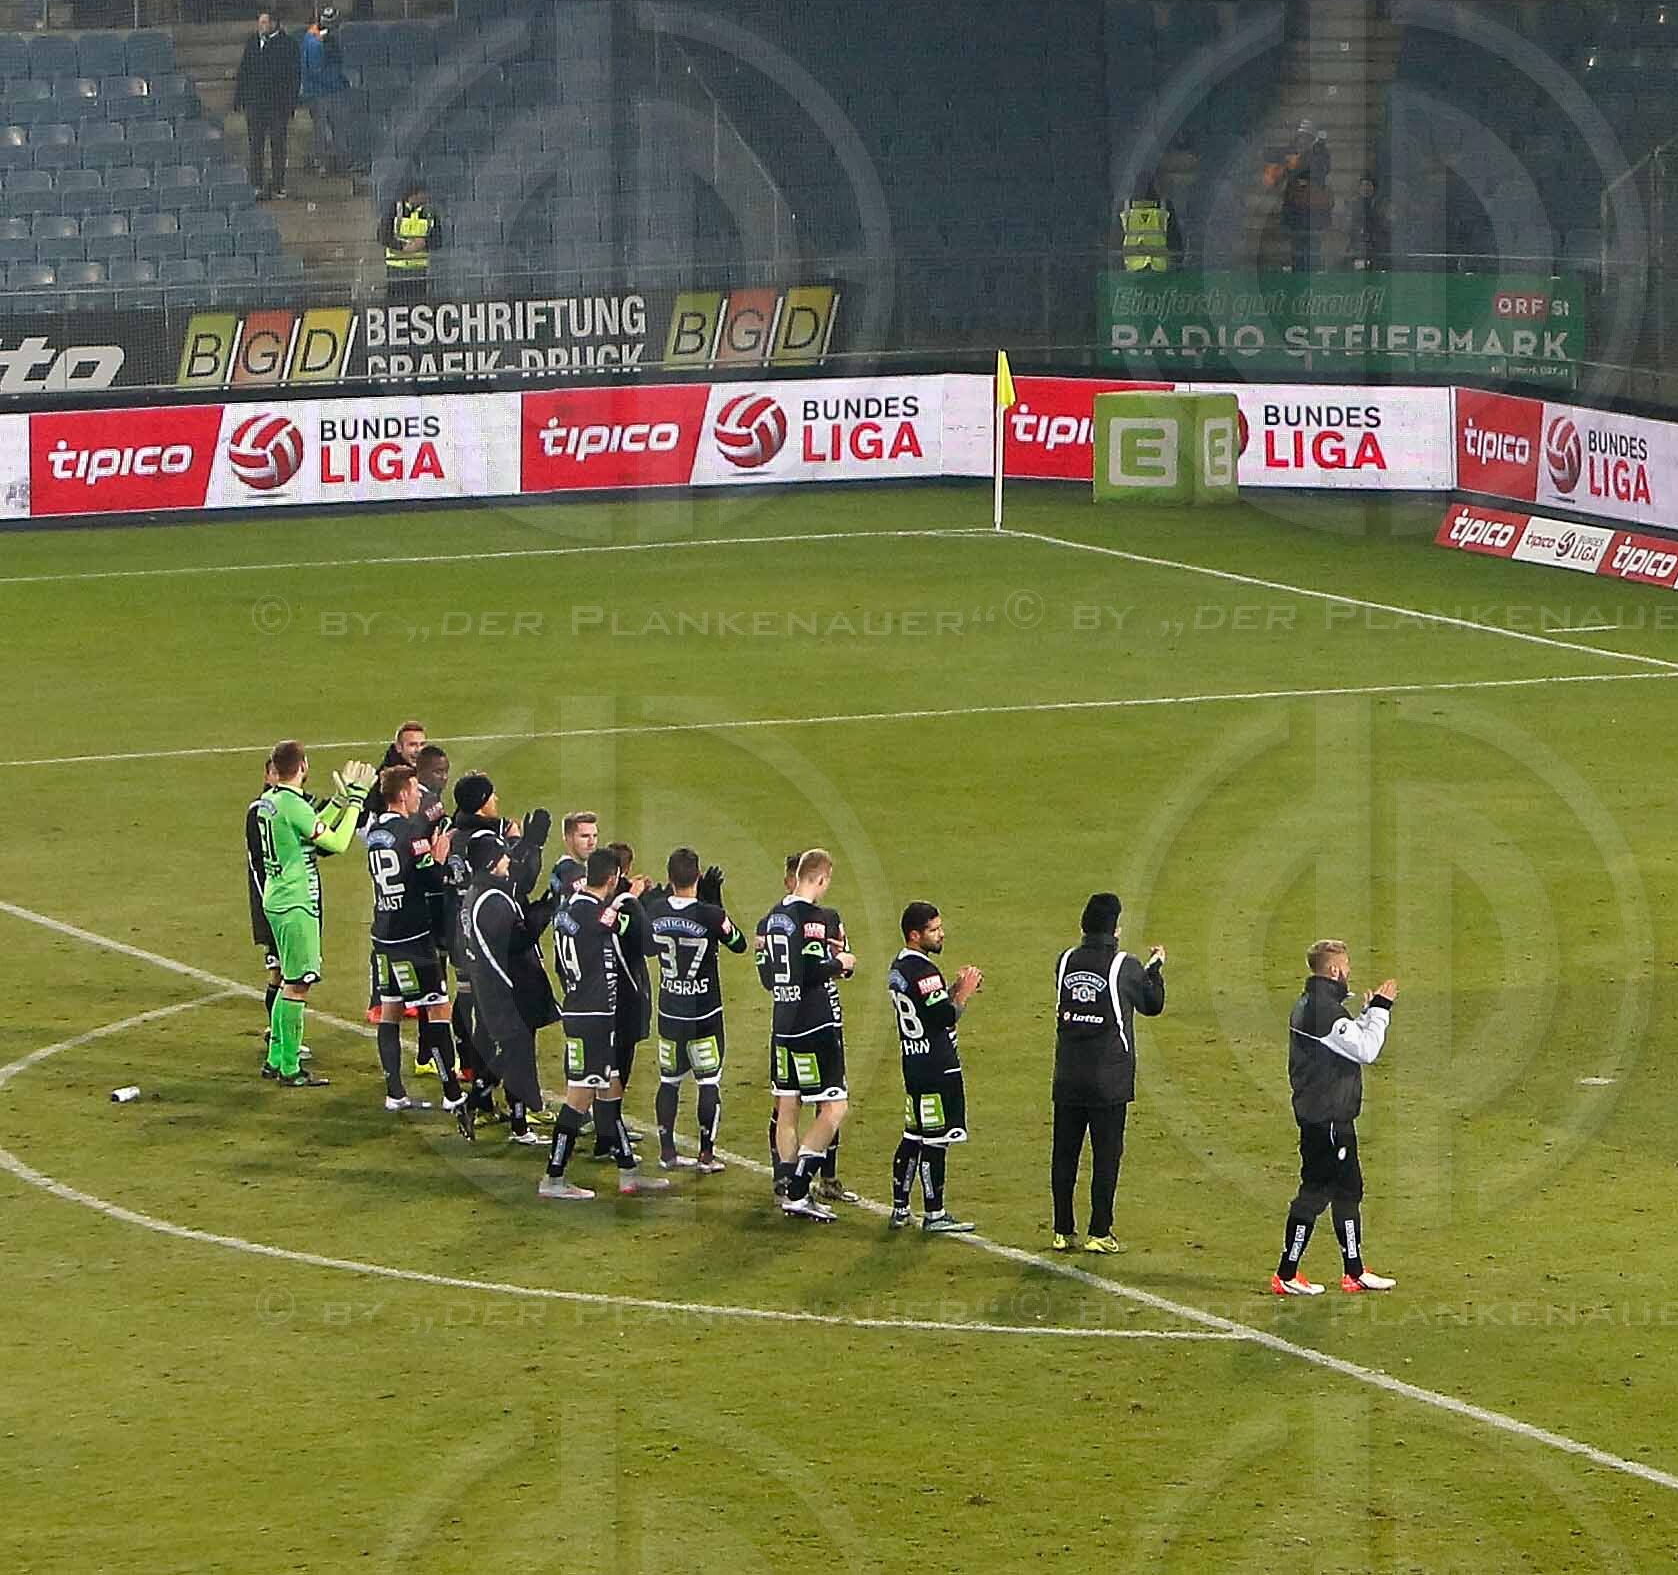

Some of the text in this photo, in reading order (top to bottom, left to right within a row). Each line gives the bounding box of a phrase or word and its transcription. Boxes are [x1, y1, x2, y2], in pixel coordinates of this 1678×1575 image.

[367, 296, 646, 347] BESCHRIFTUNG
[1497, 298, 1544, 315] ORF
[1111, 325, 1569, 362] RADIO STEIERMARK
[320, 416, 440, 441] BUNDES
[803, 396, 919, 421] BUNDES
[1010, 403, 1095, 450] tipi
[1264, 405, 1381, 428] BUNDES
[538, 416, 680, 463] tipico
[802, 421, 923, 462] LIGA
[1265, 429, 1387, 470] LIGA
[1464, 419, 1530, 465] tipico
[1589, 430, 1648, 460] BUNDES
[48, 440, 193, 485] tipico
[320, 441, 445, 484] LIGA
[1588, 456, 1650, 504] LIGA
[1450, 508, 1515, 548] tipico
[1611, 536, 1678, 578] tipico
[652, 933, 708, 980] 37
